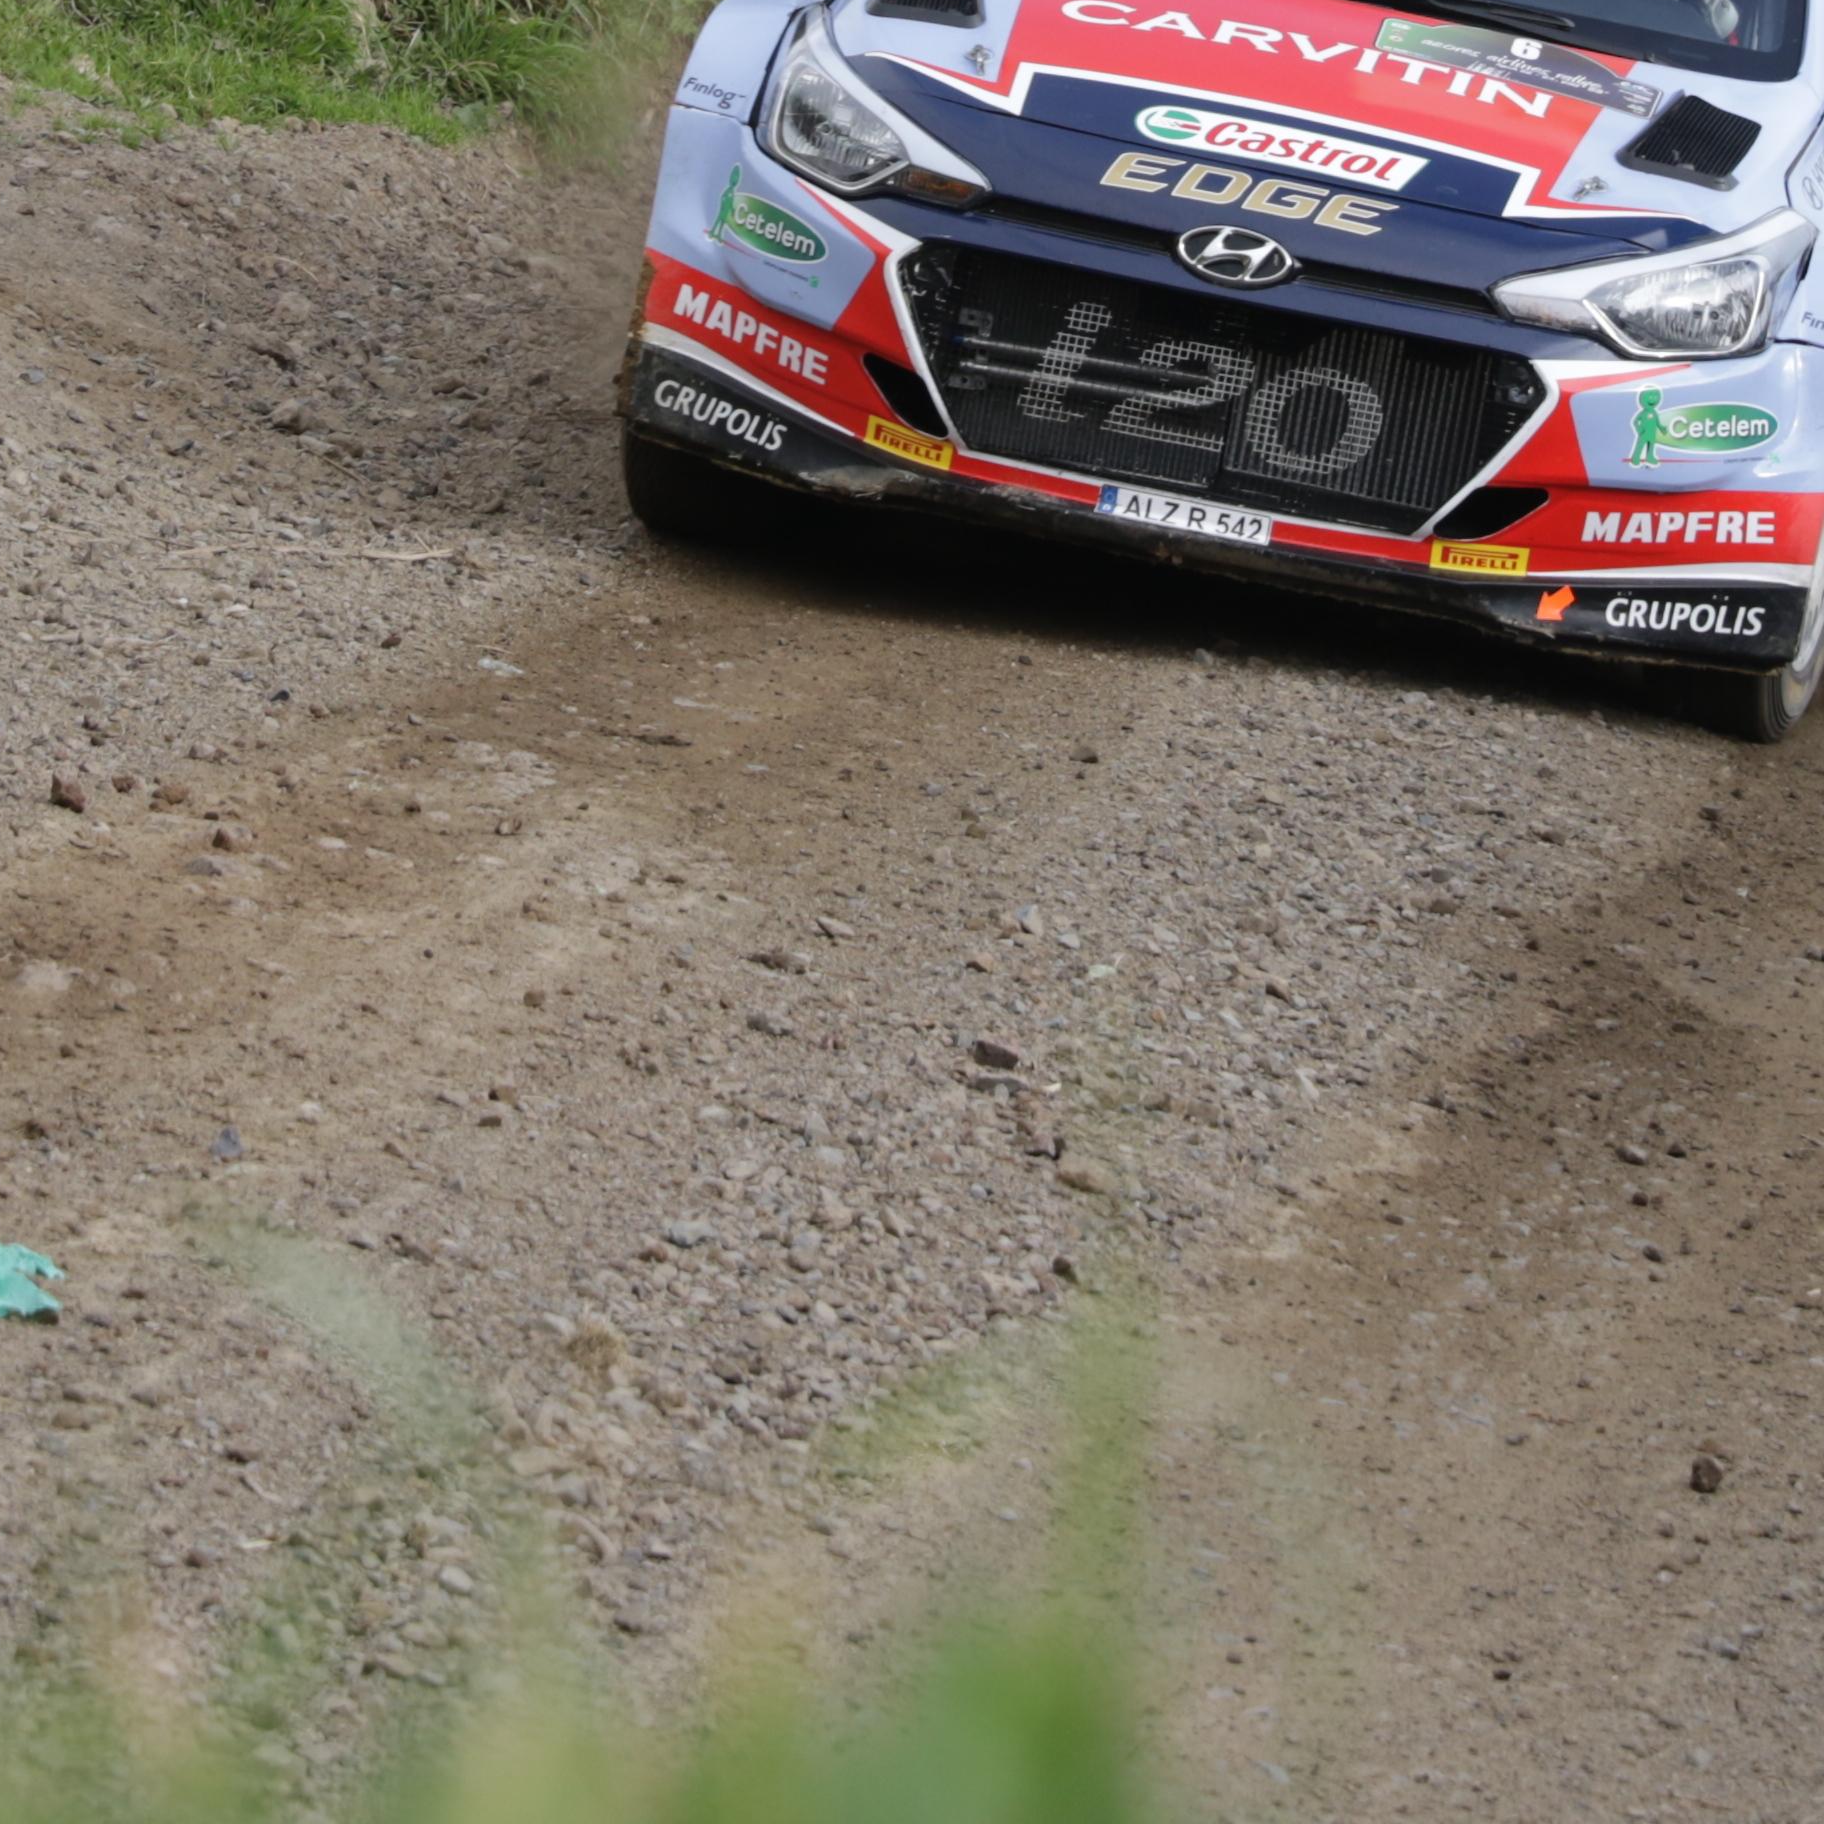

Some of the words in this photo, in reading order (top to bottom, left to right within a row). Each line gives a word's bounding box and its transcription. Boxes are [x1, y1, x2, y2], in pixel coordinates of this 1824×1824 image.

[1061, 0, 1554, 119] CARVITIN
[1509, 37, 1544, 61] 6
[683, 77, 736, 110] Finlog
[1202, 120, 1403, 181] Castrol
[1099, 151, 1400, 236] EDGE
[733, 203, 816, 257] Cetelem
[673, 283, 830, 386] MAPFRE
[1017, 301, 1383, 474] i20
[654, 379, 788, 451] GRUPOLIS
[1668, 415, 1770, 439] Cetelem
[875, 423, 945, 464] PIRELLI
[1123, 495, 1180, 524] ALZ
[1187, 507, 1210, 531] R
[1216, 514, 1264, 542] 542
[1580, 510, 1776, 545] MAPFRE
[1440, 545, 1520, 571] PIRELLI
[1604, 597, 1767, 637] GRUPOLIS
